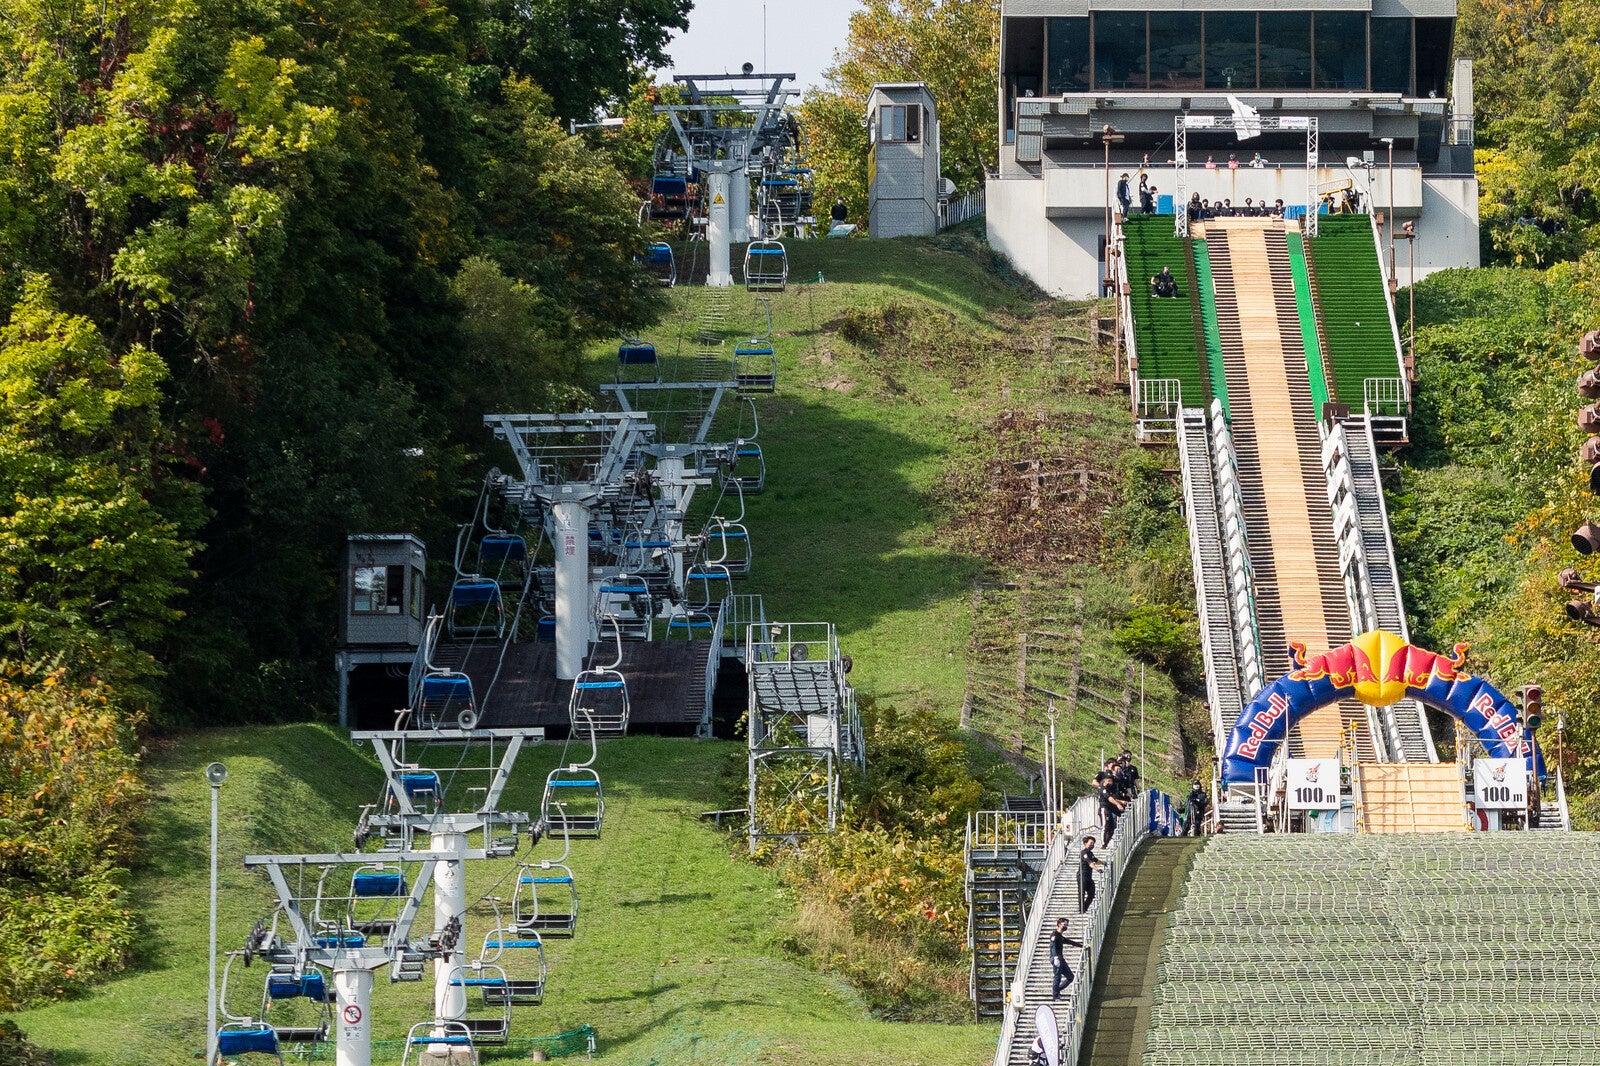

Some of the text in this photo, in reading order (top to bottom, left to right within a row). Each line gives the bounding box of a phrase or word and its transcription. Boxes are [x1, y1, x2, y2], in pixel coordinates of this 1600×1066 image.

[1475, 693, 1511, 728] Red
[1238, 693, 1287, 759] Red Bull
[1295, 787, 1336, 803] 100 m
[1482, 786, 1523, 802] 100 m
